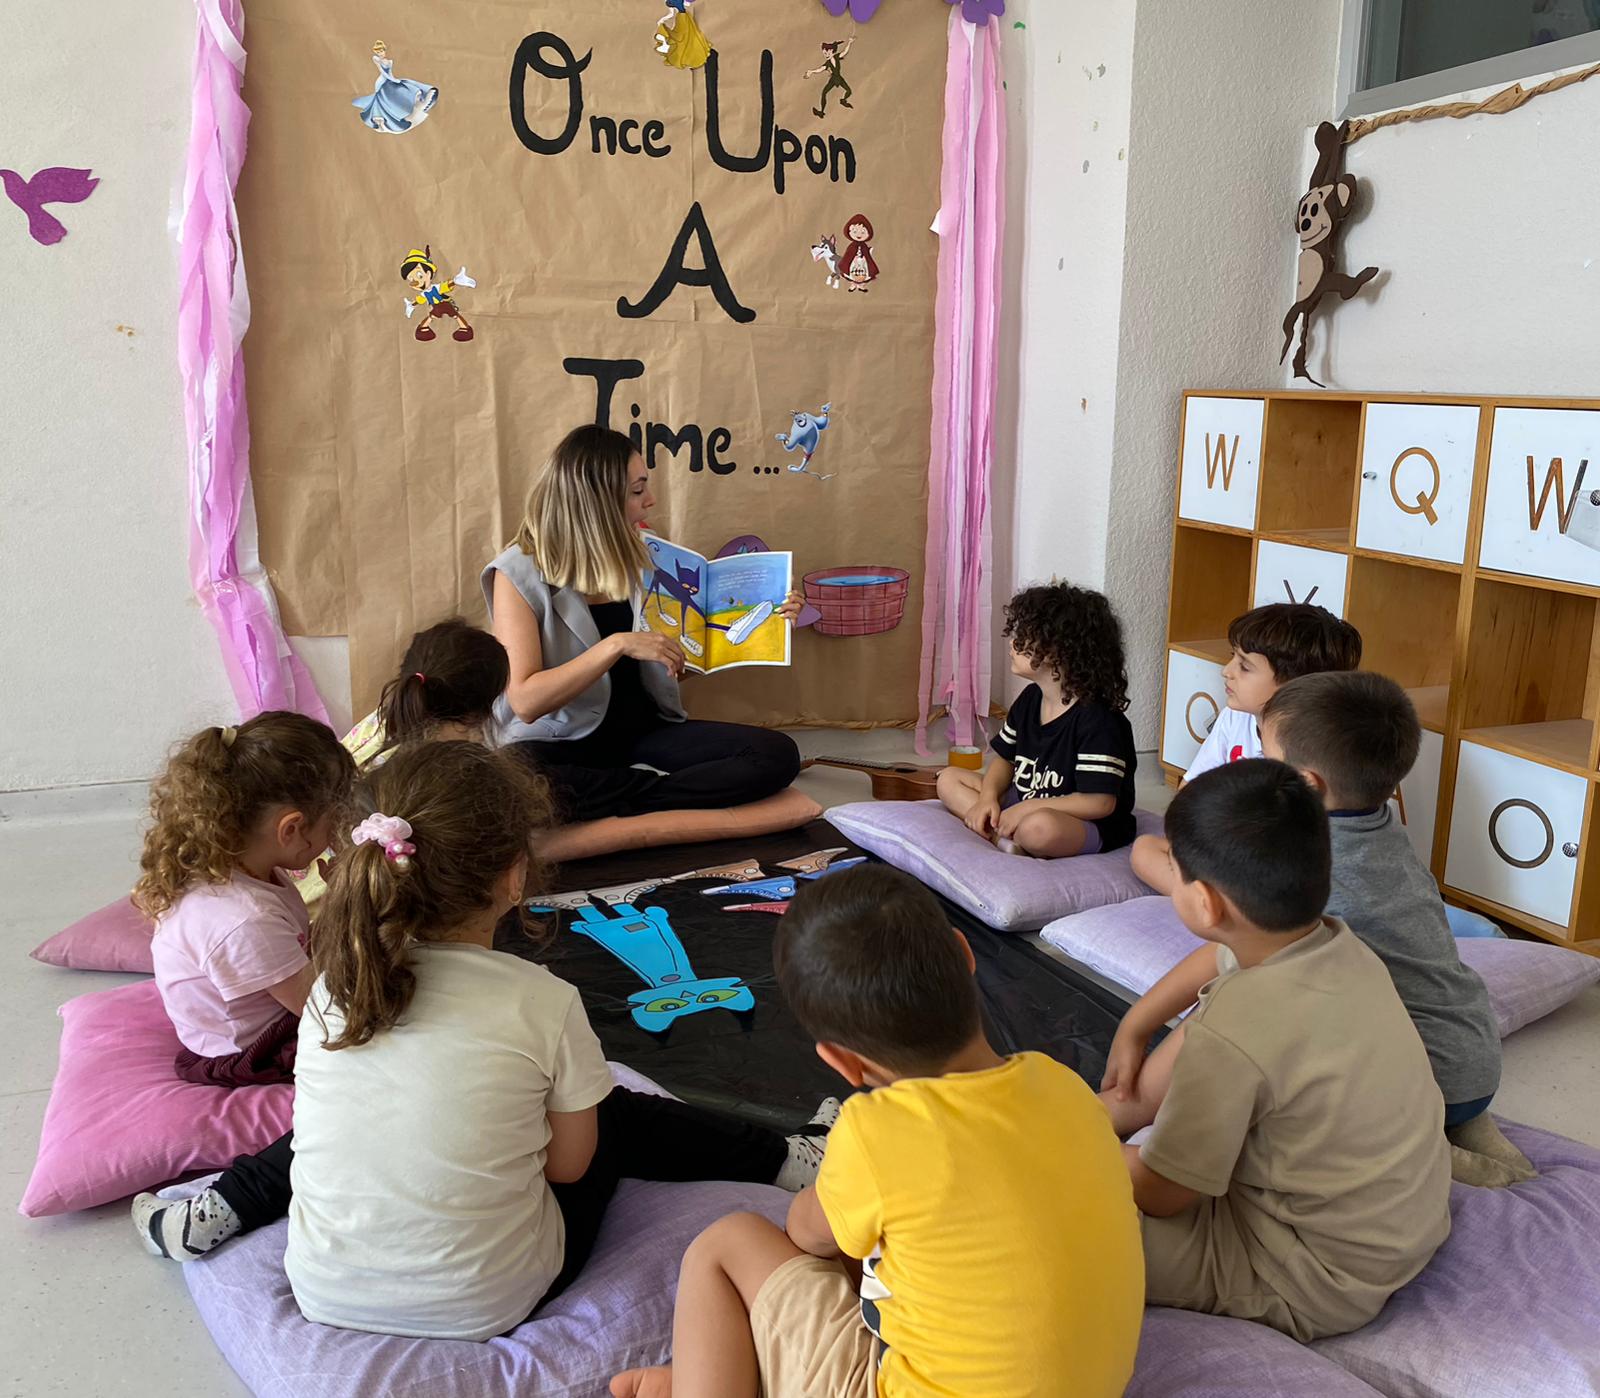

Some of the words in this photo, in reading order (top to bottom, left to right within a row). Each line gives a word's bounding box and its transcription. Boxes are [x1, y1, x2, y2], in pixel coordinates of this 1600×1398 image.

[509, 31, 671, 158] Once
[704, 49, 857, 195] Upon
[616, 201, 757, 324] A
[1205, 432, 1240, 491] W
[1390, 446, 1440, 526] Q
[1526, 455, 1589, 534] W
[1488, 798, 1555, 869] O
